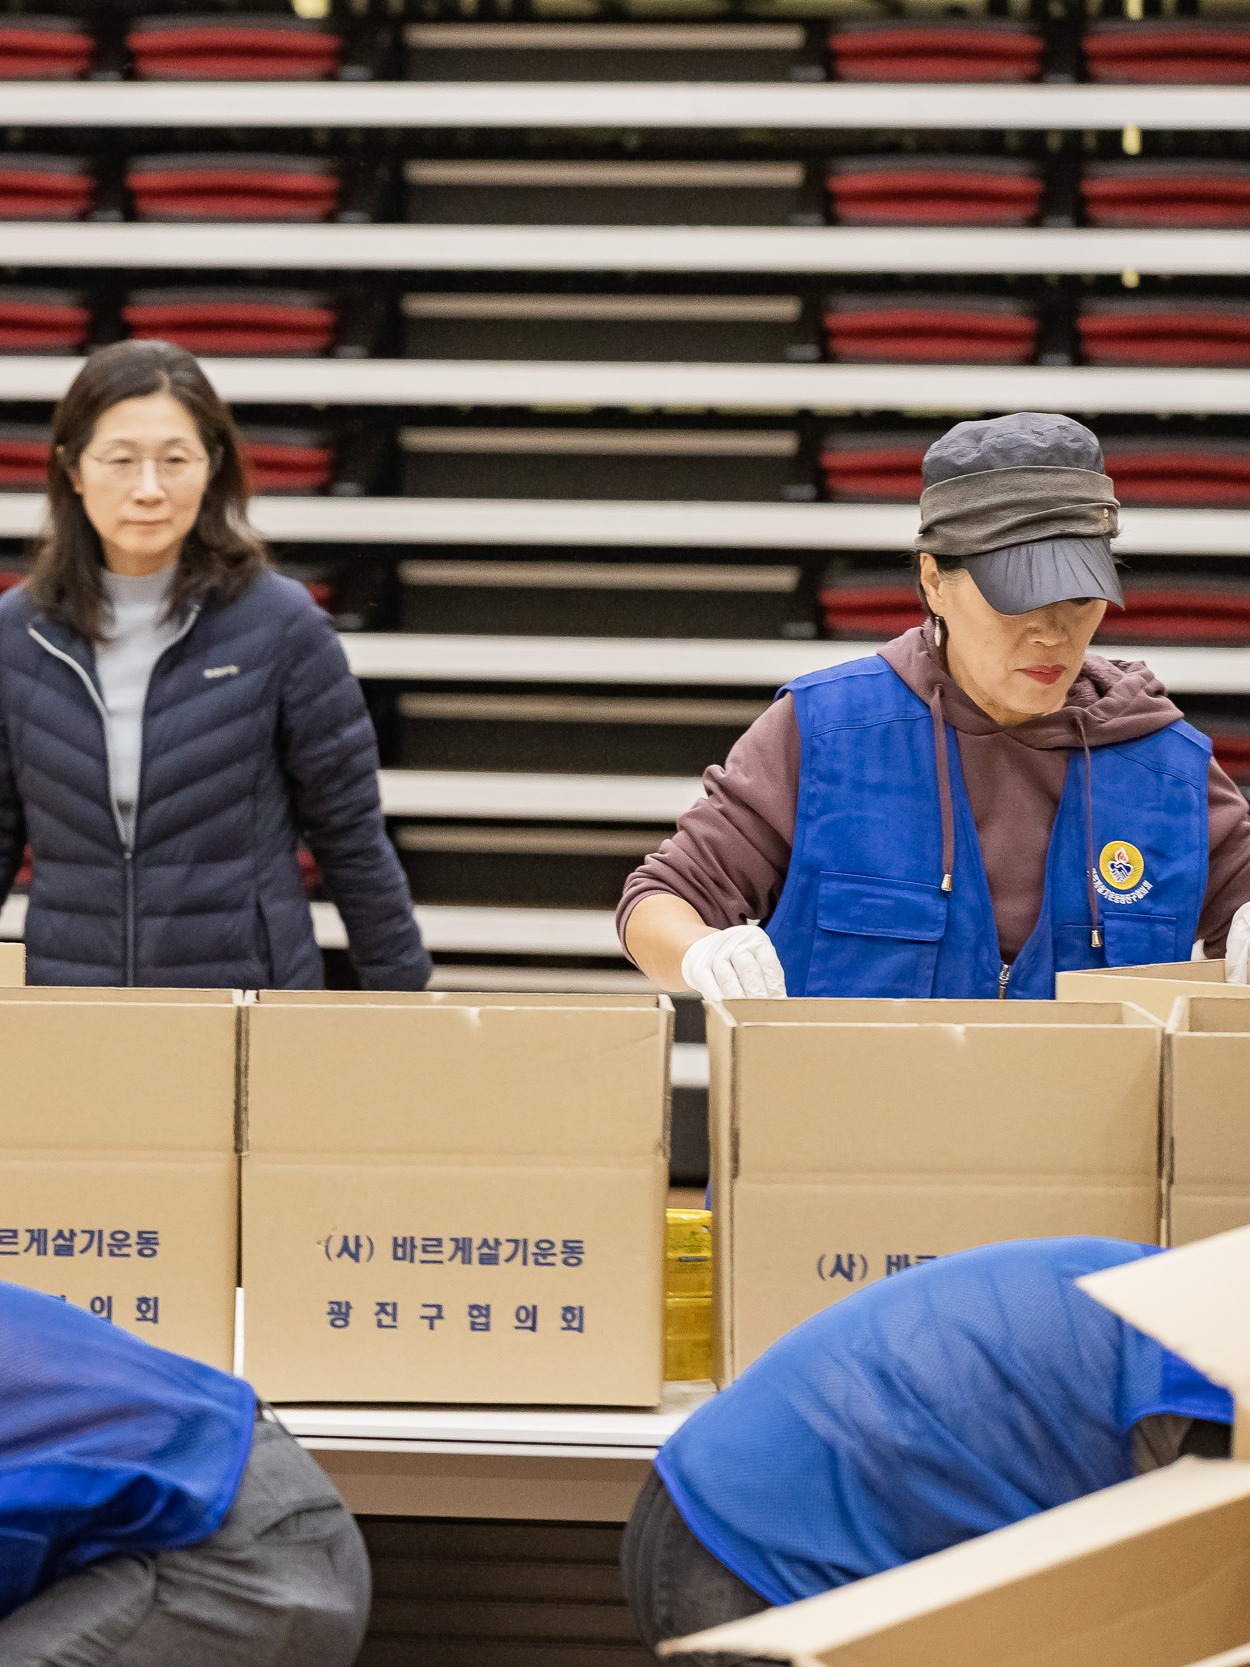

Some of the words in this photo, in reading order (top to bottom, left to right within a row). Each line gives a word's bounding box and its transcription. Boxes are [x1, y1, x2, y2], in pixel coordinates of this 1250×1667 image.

[324, 1234, 374, 1263] (사)
[392, 1235, 585, 1267] 바르게살기운동
[816, 1253, 869, 1282] (사)
